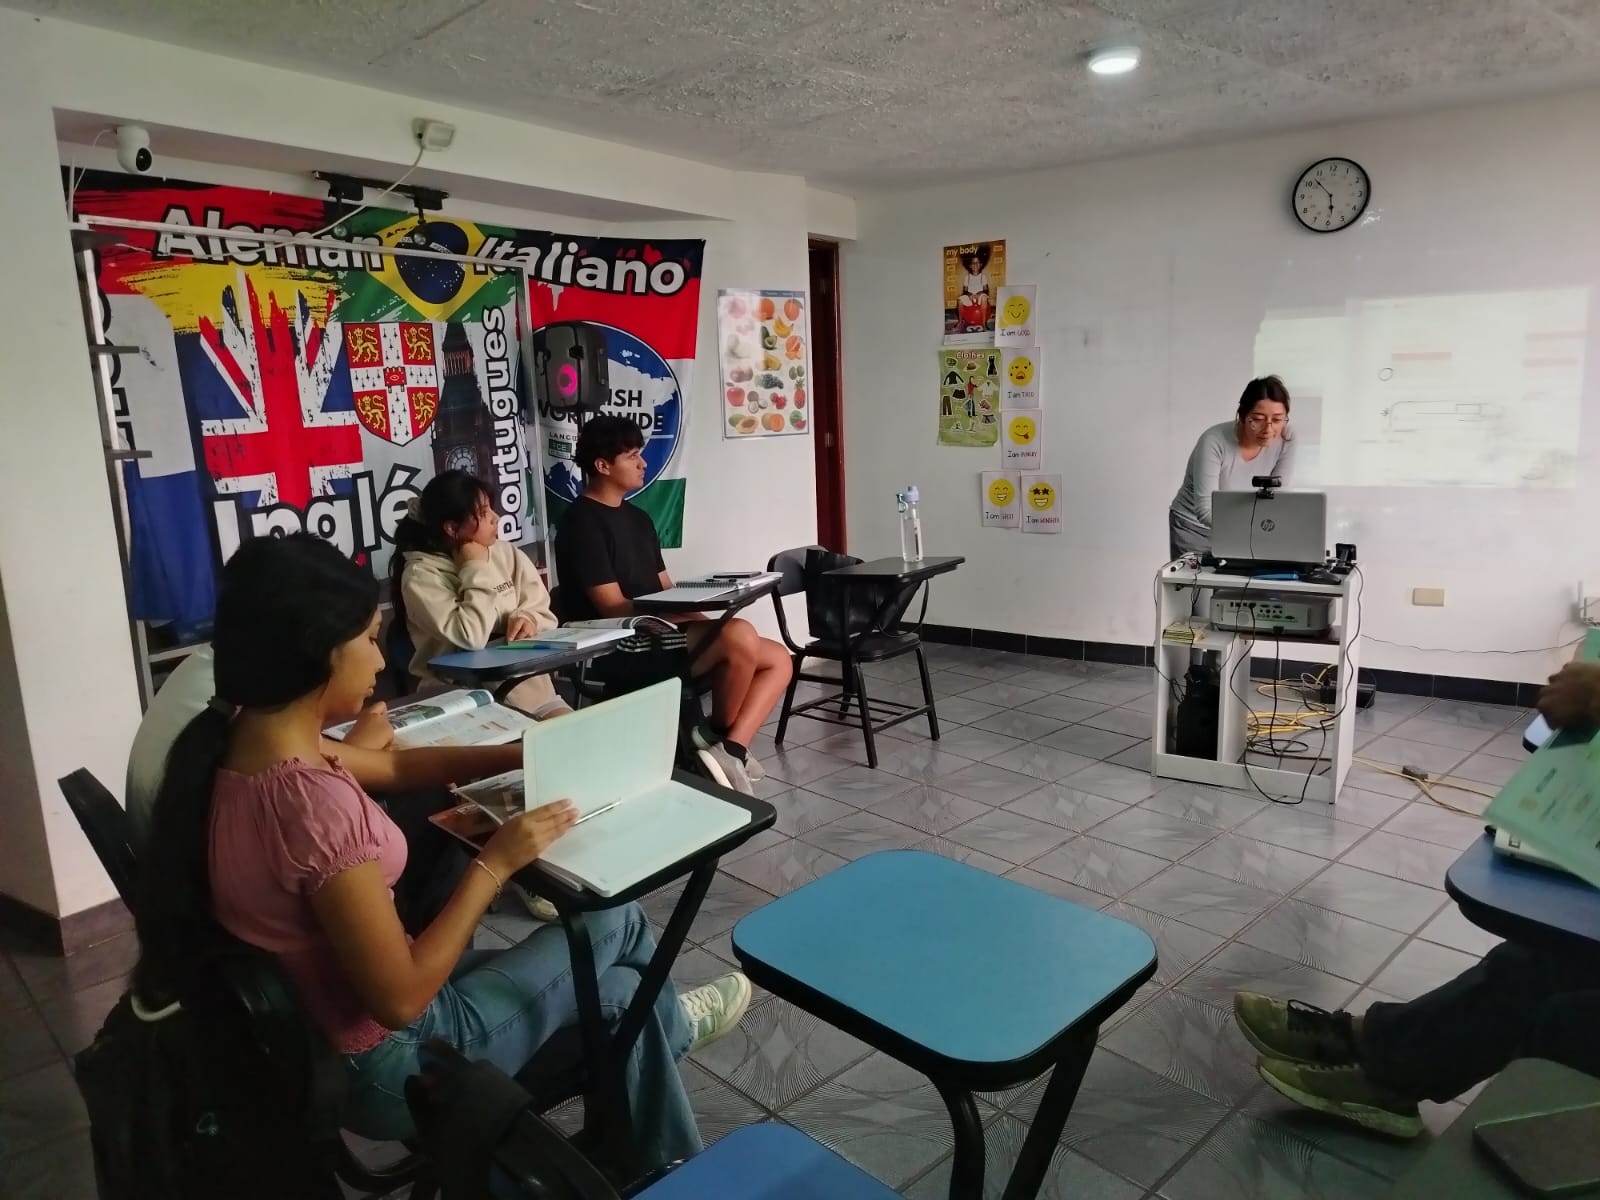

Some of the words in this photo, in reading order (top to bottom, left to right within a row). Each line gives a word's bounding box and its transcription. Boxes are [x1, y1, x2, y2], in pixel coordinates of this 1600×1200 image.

[474, 236, 686, 296] Italiano
[946, 248, 958, 257] my
[960, 245, 978, 255] body
[213, 470, 422, 567] Inglé
